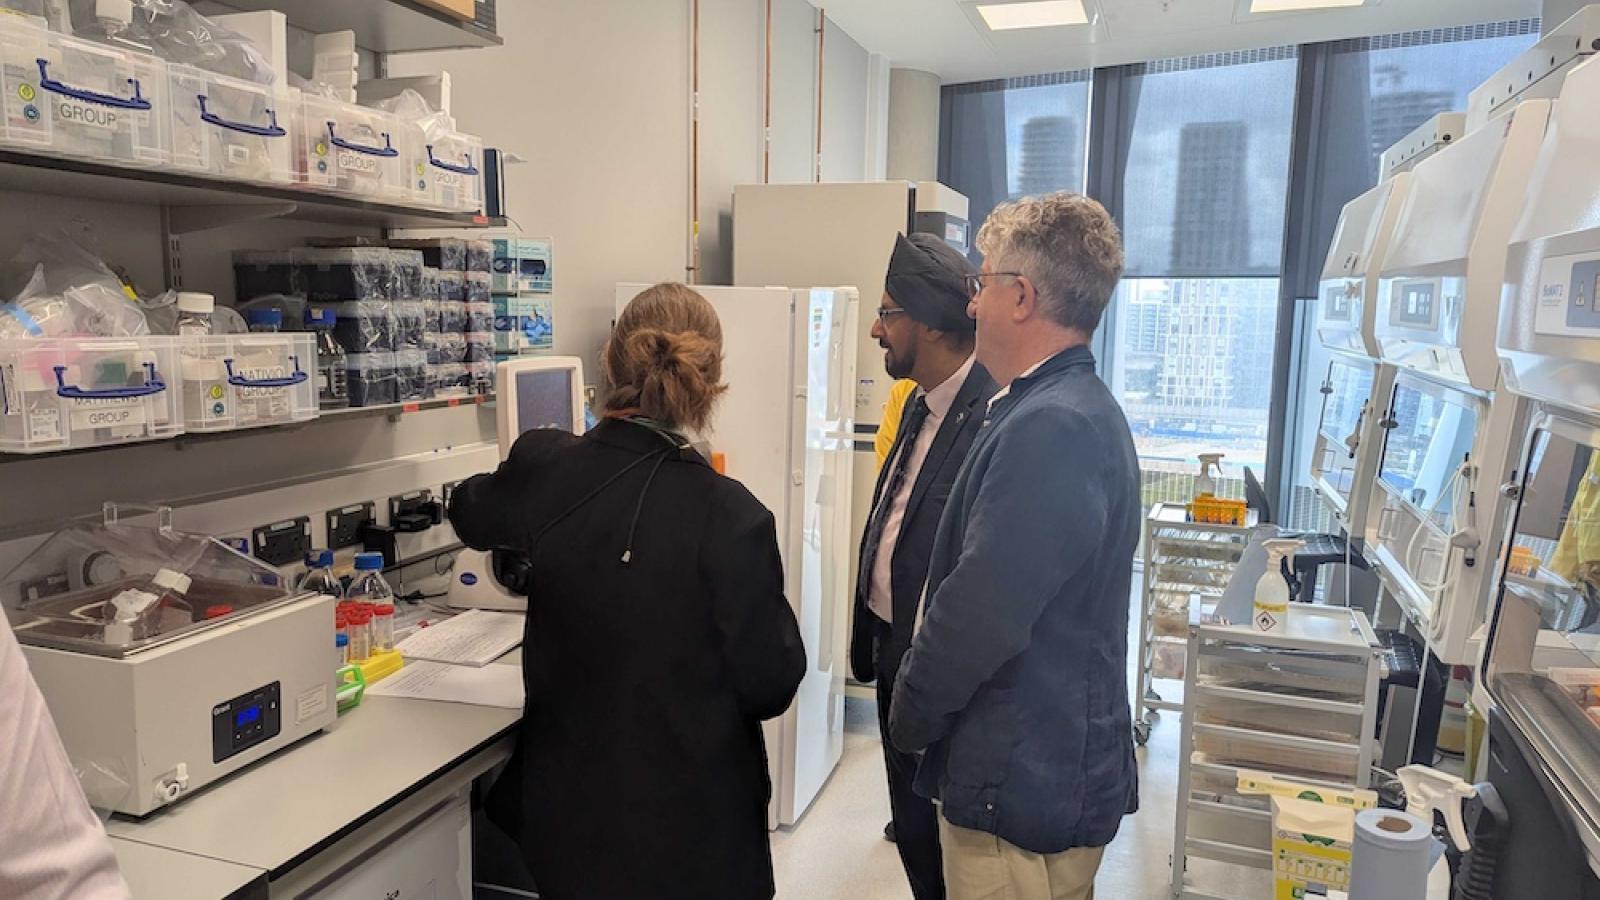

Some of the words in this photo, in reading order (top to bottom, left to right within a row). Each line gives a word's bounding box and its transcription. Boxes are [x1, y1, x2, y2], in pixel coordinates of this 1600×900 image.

[60, 103, 116, 125] GROUP
[341, 154, 375, 168] GROUP
[89, 411, 129, 424] GROUP
